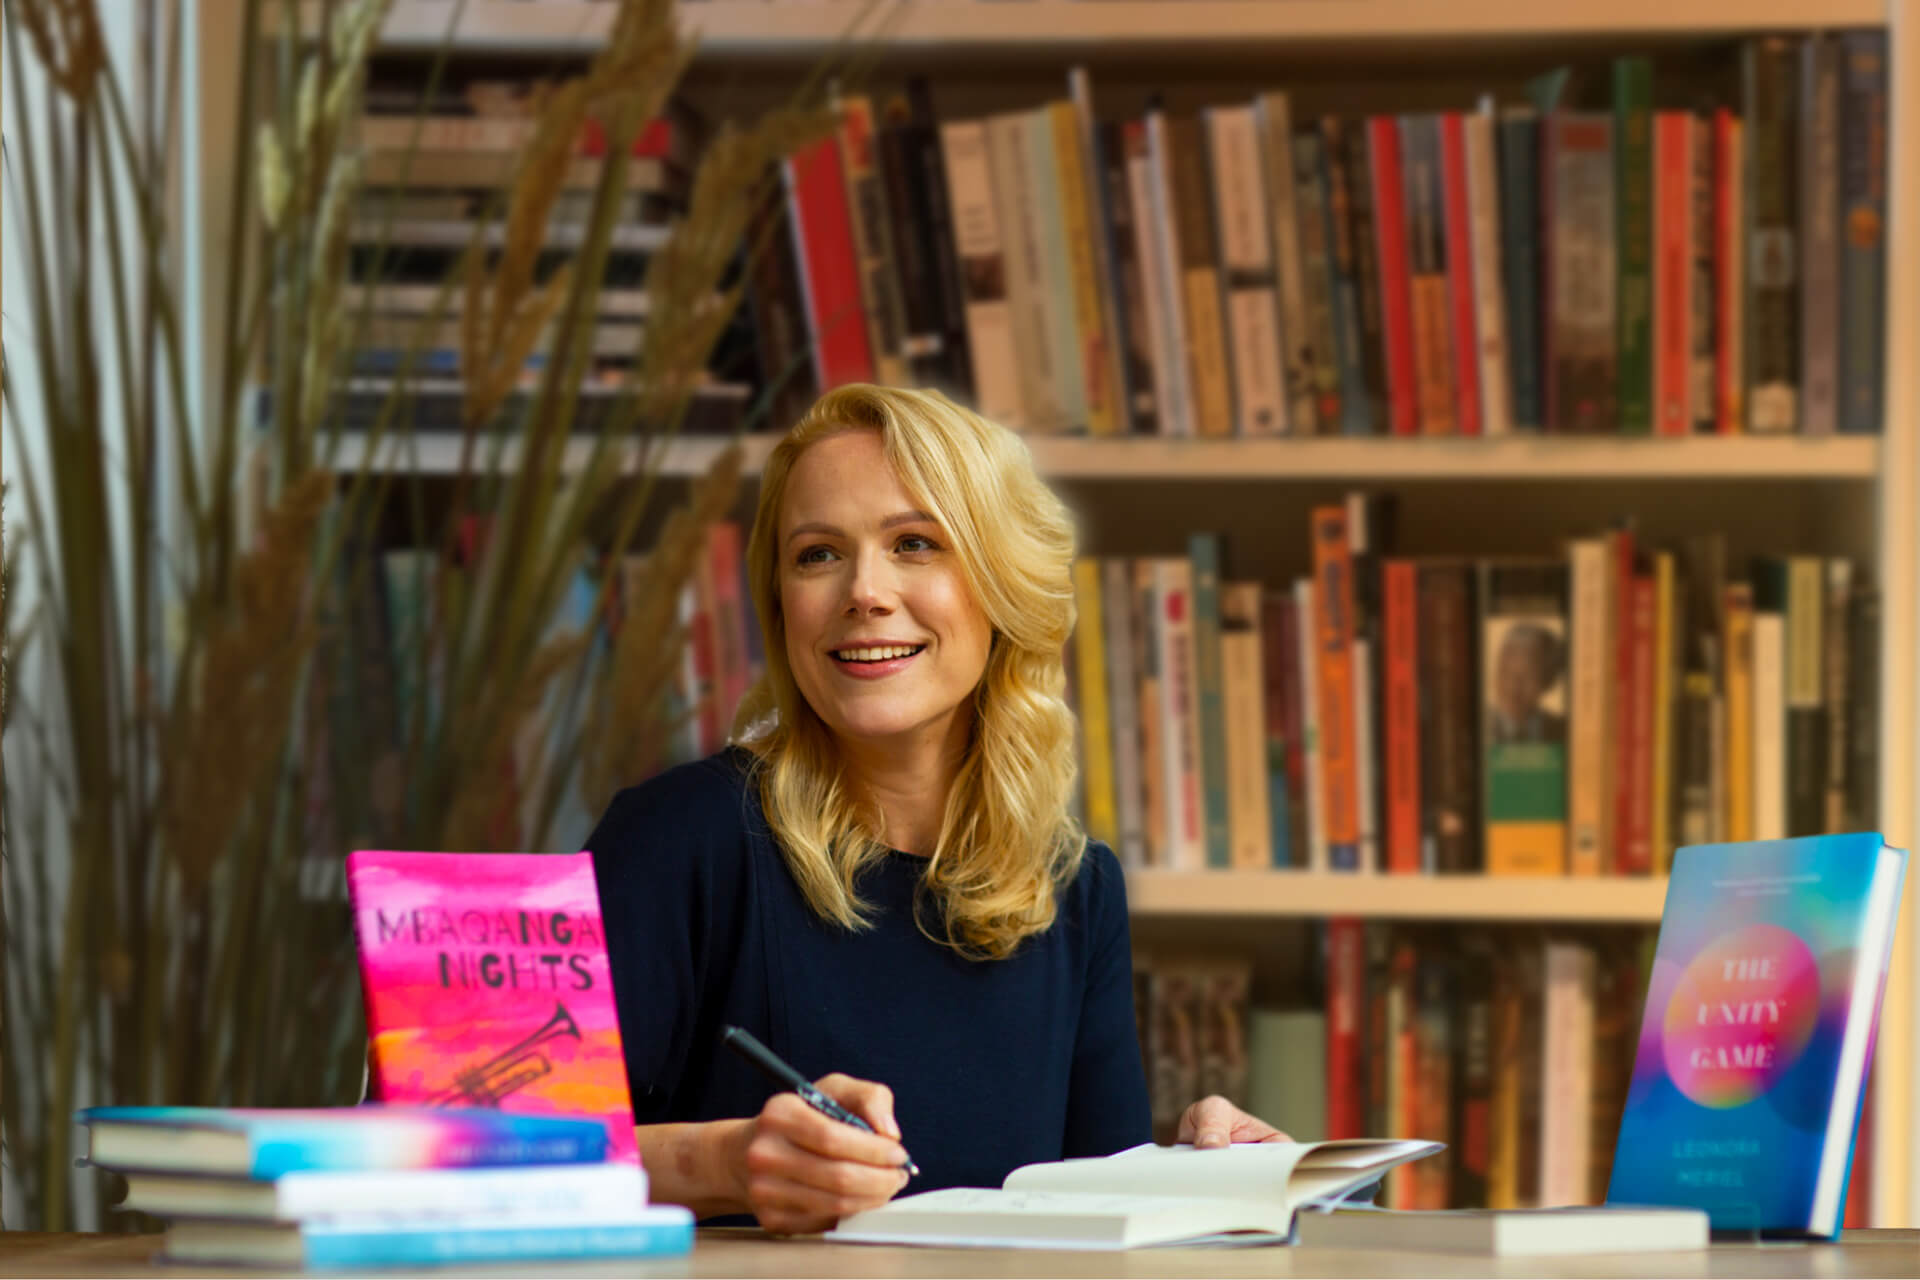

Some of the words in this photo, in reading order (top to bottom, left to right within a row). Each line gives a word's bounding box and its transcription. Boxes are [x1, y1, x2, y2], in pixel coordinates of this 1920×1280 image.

[376, 908, 600, 946] MBAQANGA
[438, 952, 594, 991] NIGHTS
[1723, 957, 1778, 982] THE
[1697, 1000, 1787, 1025] UNITY
[1689, 1044, 1777, 1070] GAME
